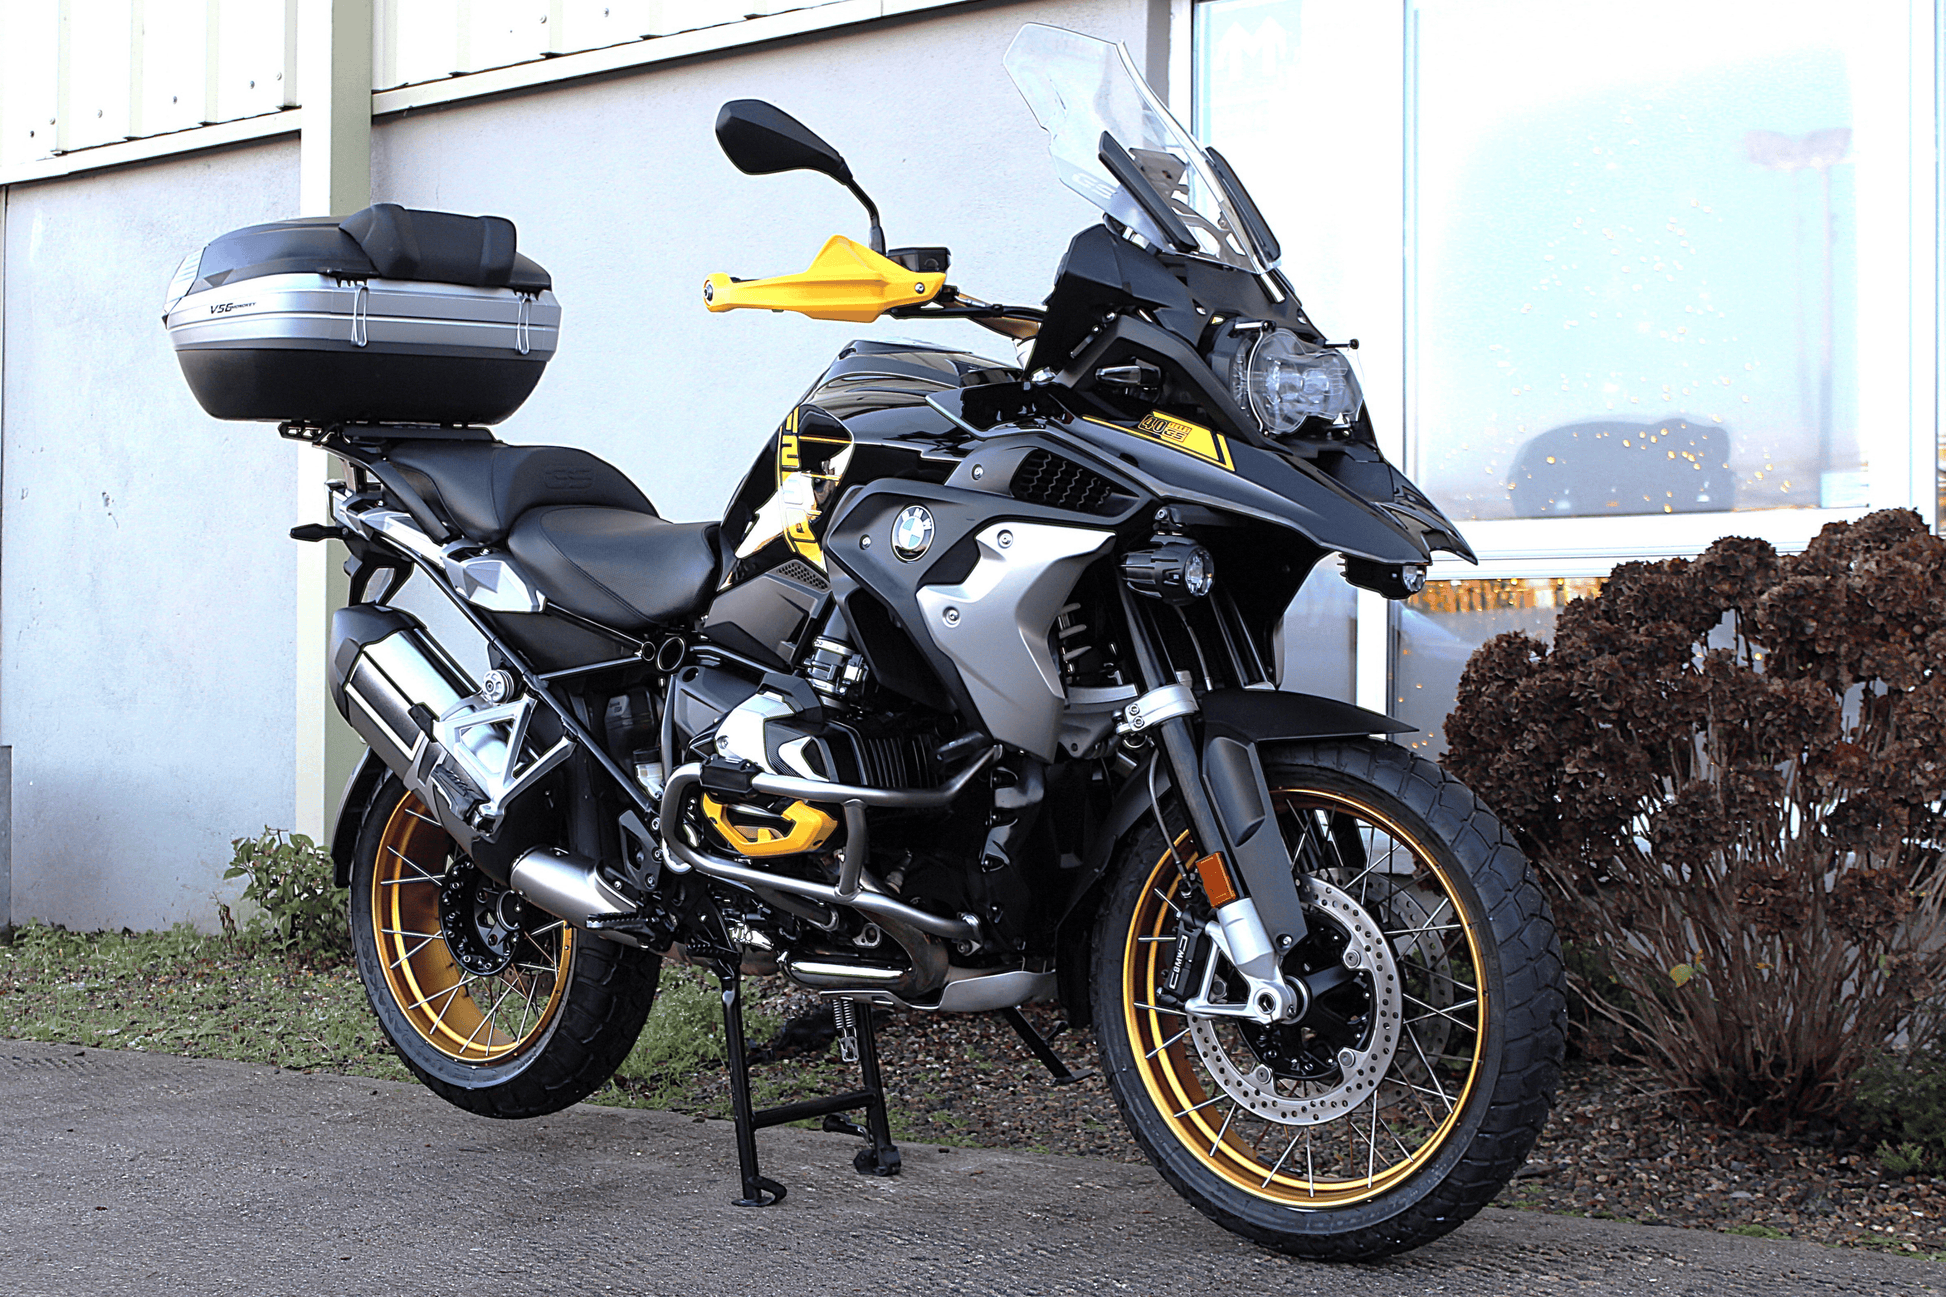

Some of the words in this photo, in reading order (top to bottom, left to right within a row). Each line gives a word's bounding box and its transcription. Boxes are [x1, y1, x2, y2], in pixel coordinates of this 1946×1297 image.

[1071, 172, 1116, 200] GS
[1140, 415, 1167, 433] 40
[901, 507, 932, 531] BMW
[1173, 949, 1186, 973] BMW
